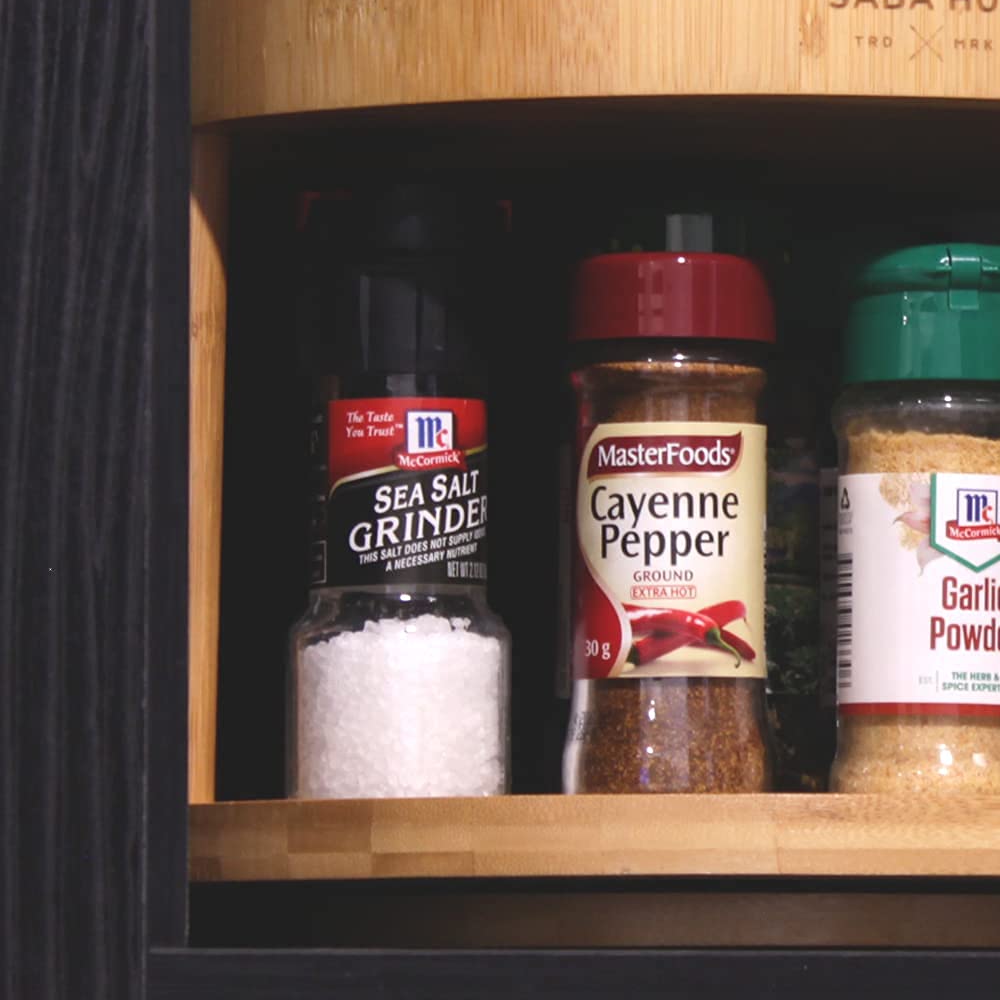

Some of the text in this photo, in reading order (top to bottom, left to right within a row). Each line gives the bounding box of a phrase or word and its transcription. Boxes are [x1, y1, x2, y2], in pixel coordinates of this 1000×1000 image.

[855, 35, 993, 50] TRD MRK
[347, 412, 394, 423] The Taste
[346, 427, 364, 438] You
[398, 452, 460, 466] McCormick
[597, 440, 732, 467] MasterFoods
[590, 486, 739, 528] Cayenne
[349, 496, 487, 552] GRINDER
[359, 552, 379, 565] THIS
[380, 546, 402, 561] SALT
[404, 541, 428, 555] DOES
[430, 537, 446, 550] NOT
[449, 533, 473, 546] SUPPLY
[601, 524, 730, 566] Pepper
[385, 542, 478, 572] A NECESSARY NUTRIENT
[633, 571, 694, 582] GROUND
[632, 587, 694, 598] EXTRA HOT
[601, 642, 611, 660] g
[952, 672, 967, 680] THE
[970, 672, 991, 681] HERB
[942, 682, 968, 691] SPICE
